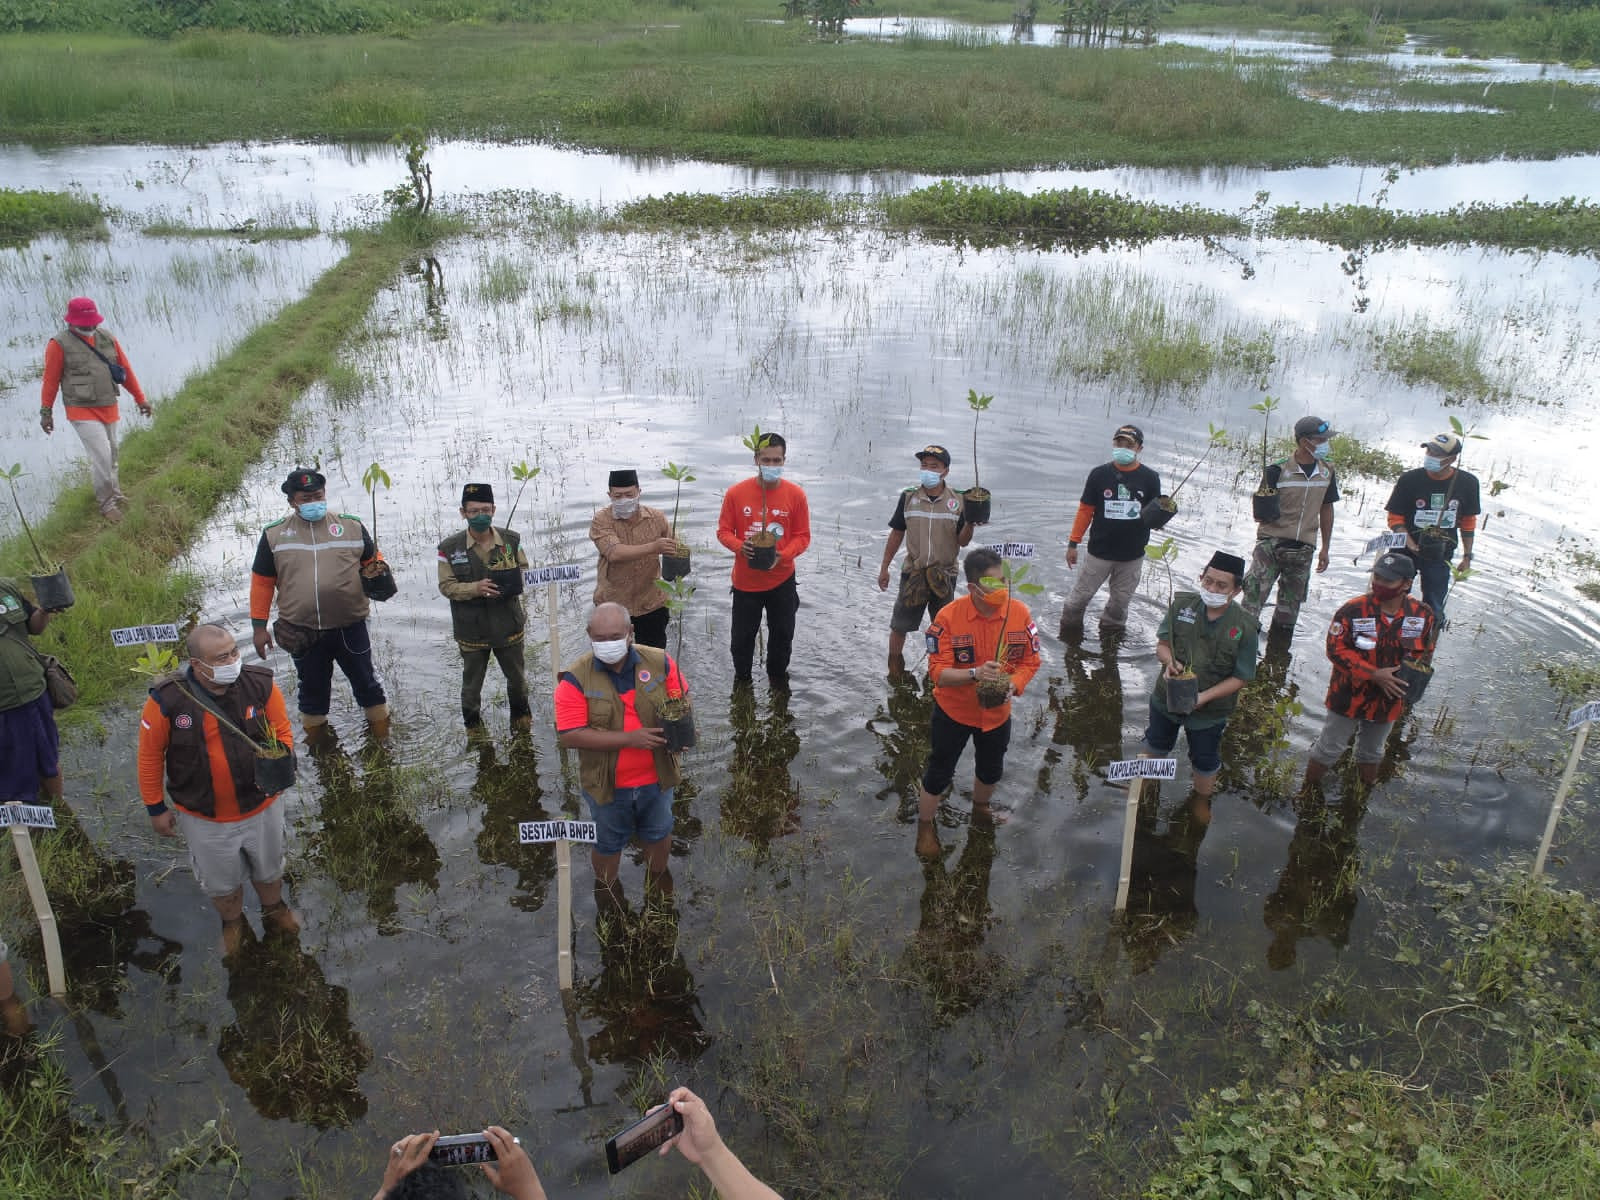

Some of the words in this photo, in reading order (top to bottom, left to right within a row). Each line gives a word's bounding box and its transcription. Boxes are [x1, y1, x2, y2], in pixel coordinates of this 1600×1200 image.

[524, 570, 539, 585] PCNU
[552, 566, 580, 581] LUMAJANG
[112, 629, 133, 644] KETUA
[1109, 761, 1139, 779] KAPOLRES
[1140, 760, 1175, 777] LUMAJANG
[21, 807, 53, 826] LUMAJANG
[521, 821, 567, 841] SESTAMA
[569, 822, 595, 841] BNPB
